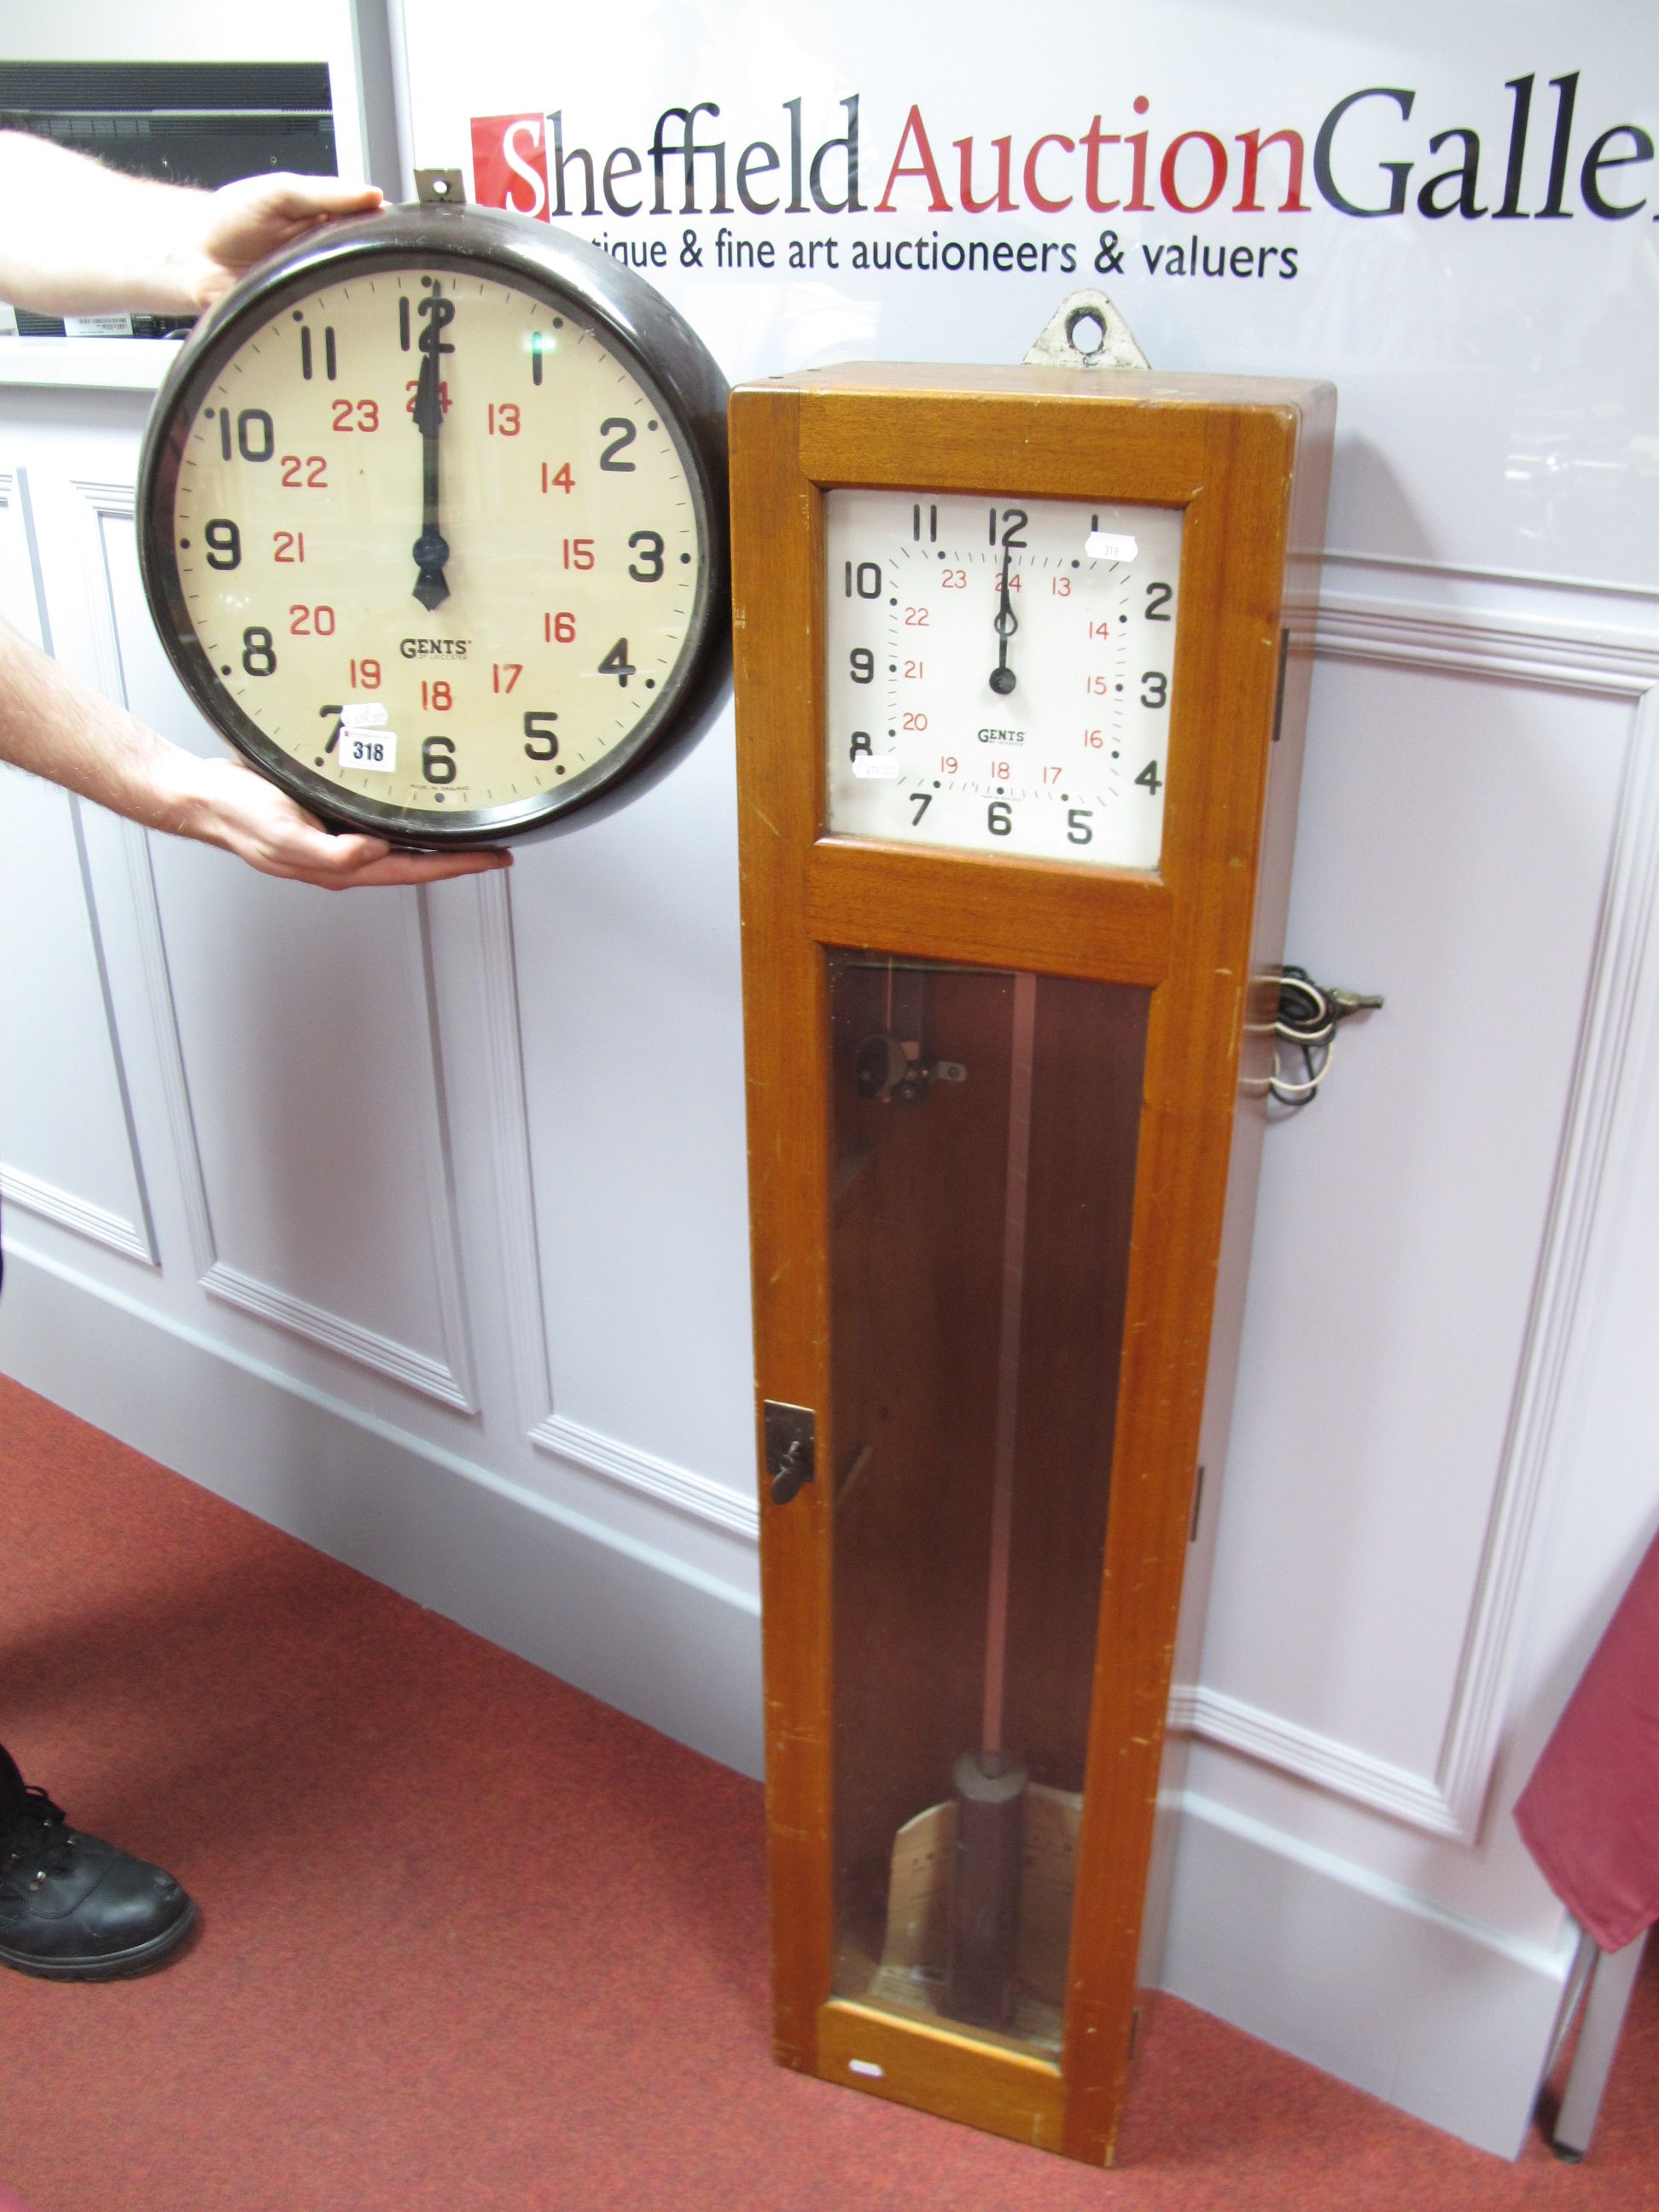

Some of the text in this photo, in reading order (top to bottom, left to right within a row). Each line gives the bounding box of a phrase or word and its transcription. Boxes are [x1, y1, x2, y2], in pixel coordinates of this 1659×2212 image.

[680, 229, 703, 267] &
[716, 227, 775, 268] fine
[789, 236, 839, 269] art
[852, 230, 1077, 272] auctioneers
[1094, 230, 1124, 275] &
[1143, 235, 1298, 279] valuers
[398, 294, 457, 354] 12
[300, 325, 337, 381] 11
[531, 330, 544, 387] 1
[331, 399, 380, 434] 23
[487, 403, 521, 438] 13
[218, 406, 275, 463] 10
[599, 416, 637, 473] 2
[280, 455, 329, 490] 22
[541, 463, 575, 495] 14
[913, 503, 938, 543] 11
[988, 507, 1028, 549] 12
[204, 518, 242, 571] 9
[272, 531, 306, 564] 21
[562, 538, 596, 572] 15
[628, 530, 665, 583] 3
[844, 561, 882, 600] 10
[941, 568, 968, 591] 23
[994, 572, 1022, 593] 24
[1051, 575, 1073, 599] 13
[904, 606, 929, 627] 22
[1144, 581, 1173, 622] 2
[288, 603, 336, 637] 20
[544, 611, 577, 644] 16
[1088, 621, 1109, 642] 14
[242, 626, 277, 677] 8
[597, 637, 637, 688] 4
[849, 647, 875, 684] 9
[349, 658, 382, 690] 19
[492, 663, 524, 695] 17
[903, 660, 925, 680] 21
[1086, 675, 1108, 697] 15
[422, 681, 454, 712] 18
[1140, 671, 1167, 709] 3
[318, 704, 346, 754] 7
[523, 711, 559, 761] 5
[902, 712, 928, 733] 20
[1083, 730, 1104, 749] 16
[352, 740, 384, 762] 318
[422, 736, 457, 785] 6
[940, 757, 959, 776] 19
[991, 761, 1011, 781] 18
[1042, 765, 1063, 785] 17
[1134, 760, 1163, 796] 4
[909, 792, 933, 827] 7
[987, 801, 1012, 836] 6
[1067, 808, 1093, 845] 5
